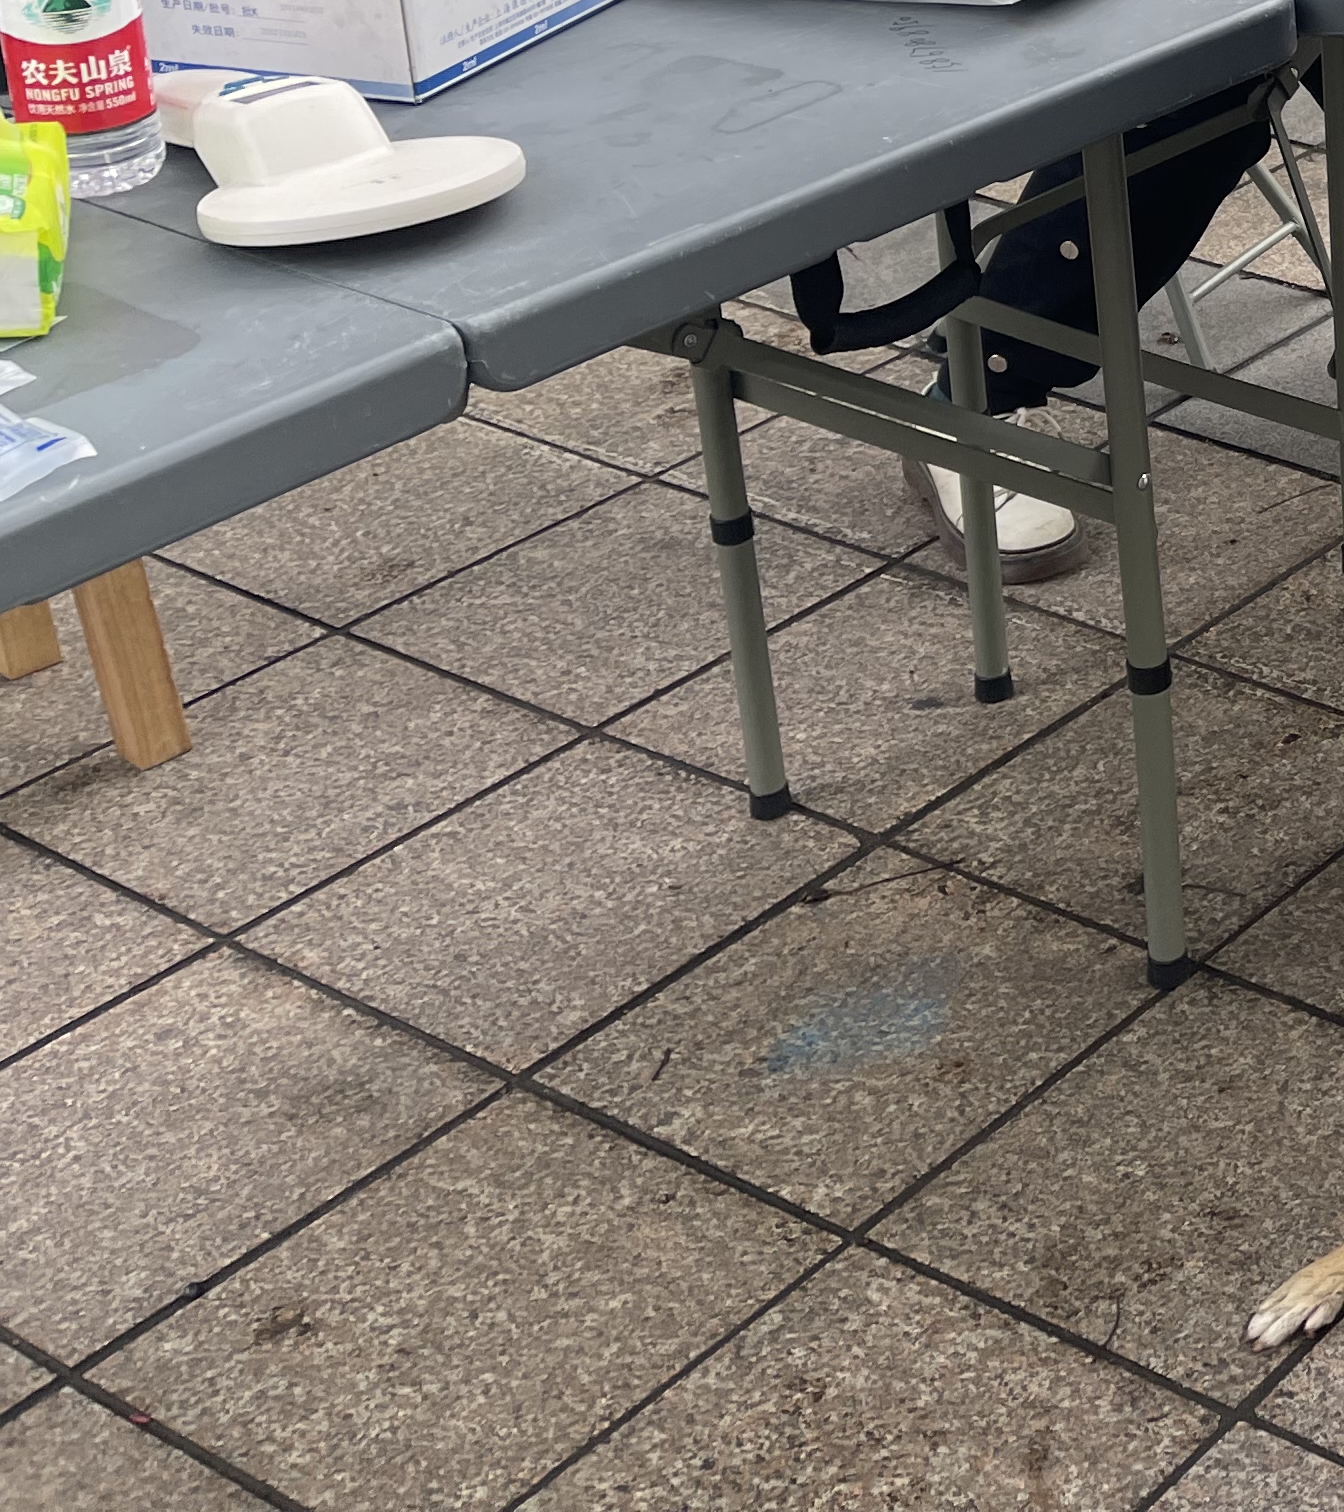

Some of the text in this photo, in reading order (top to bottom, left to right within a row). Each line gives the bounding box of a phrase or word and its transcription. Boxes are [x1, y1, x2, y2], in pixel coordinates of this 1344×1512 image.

[21, 49, 132, 86] 农夫山泉
[25, 76, 134, 102] NONGFU SPRING
